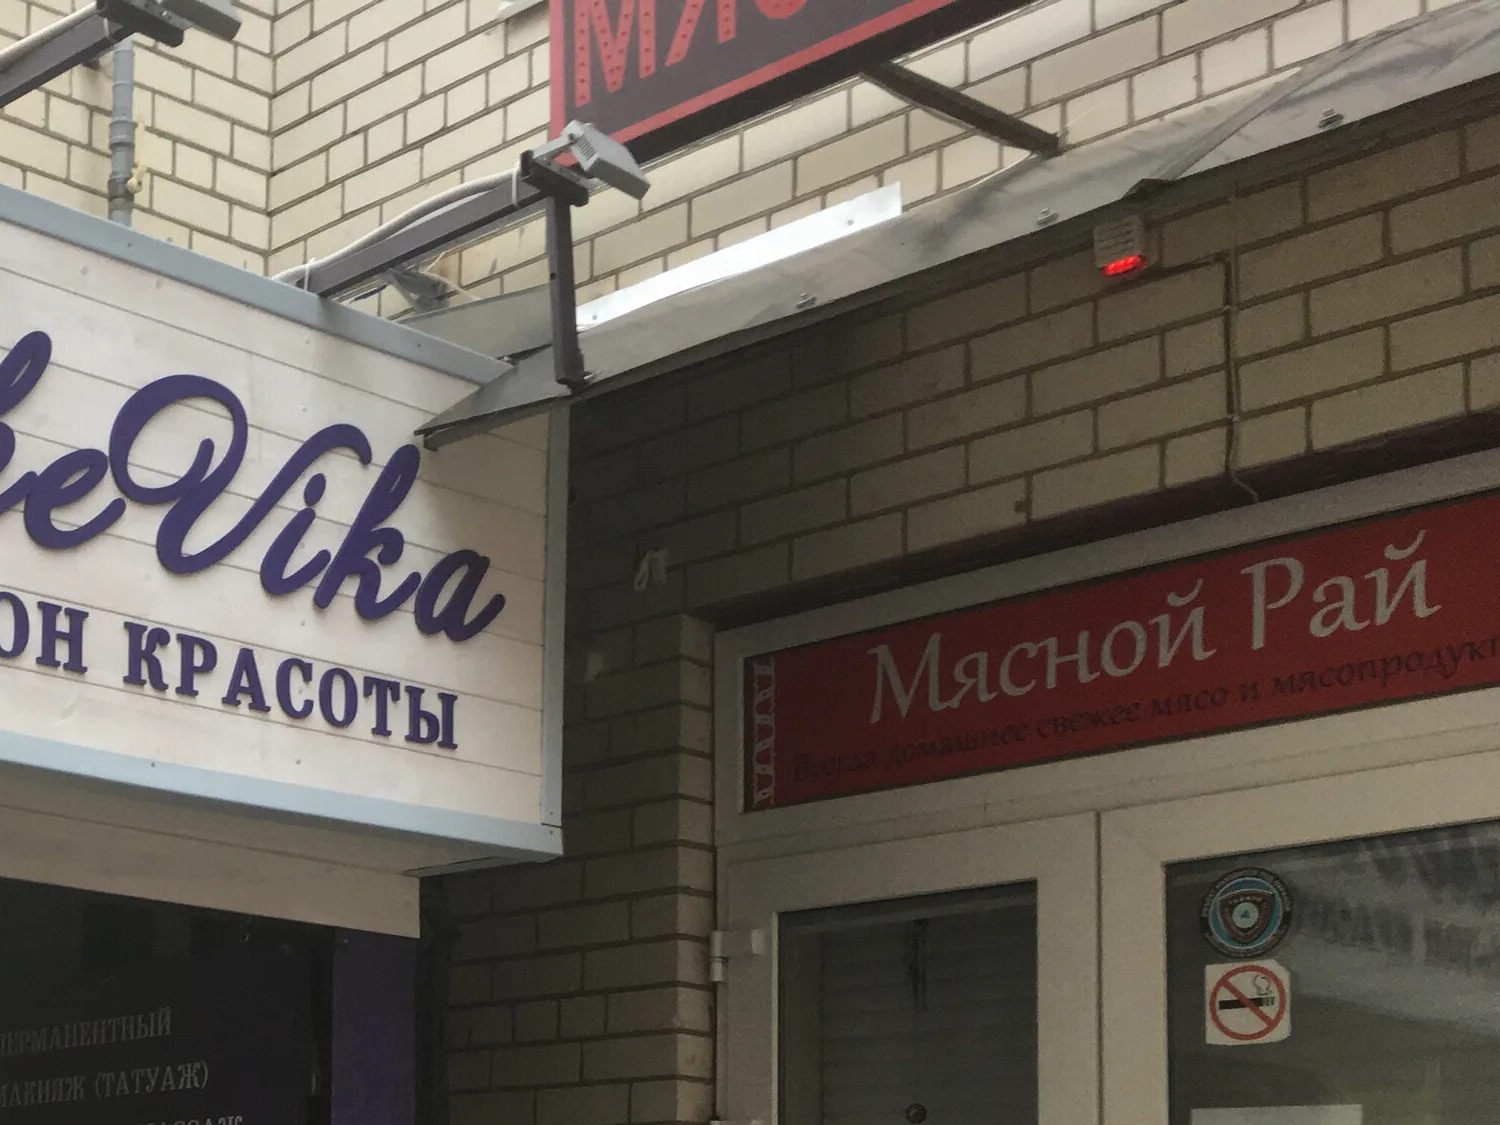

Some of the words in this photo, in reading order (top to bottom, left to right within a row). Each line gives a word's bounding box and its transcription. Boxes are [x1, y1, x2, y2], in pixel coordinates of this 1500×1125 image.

[123, 621, 459, 752] КРАСОТЫ
[867, 579, 1215, 724] Мясной
[1241, 529, 1442, 650] Рай
[95, 1061, 209, 1101] (ТАТУАЖ)
